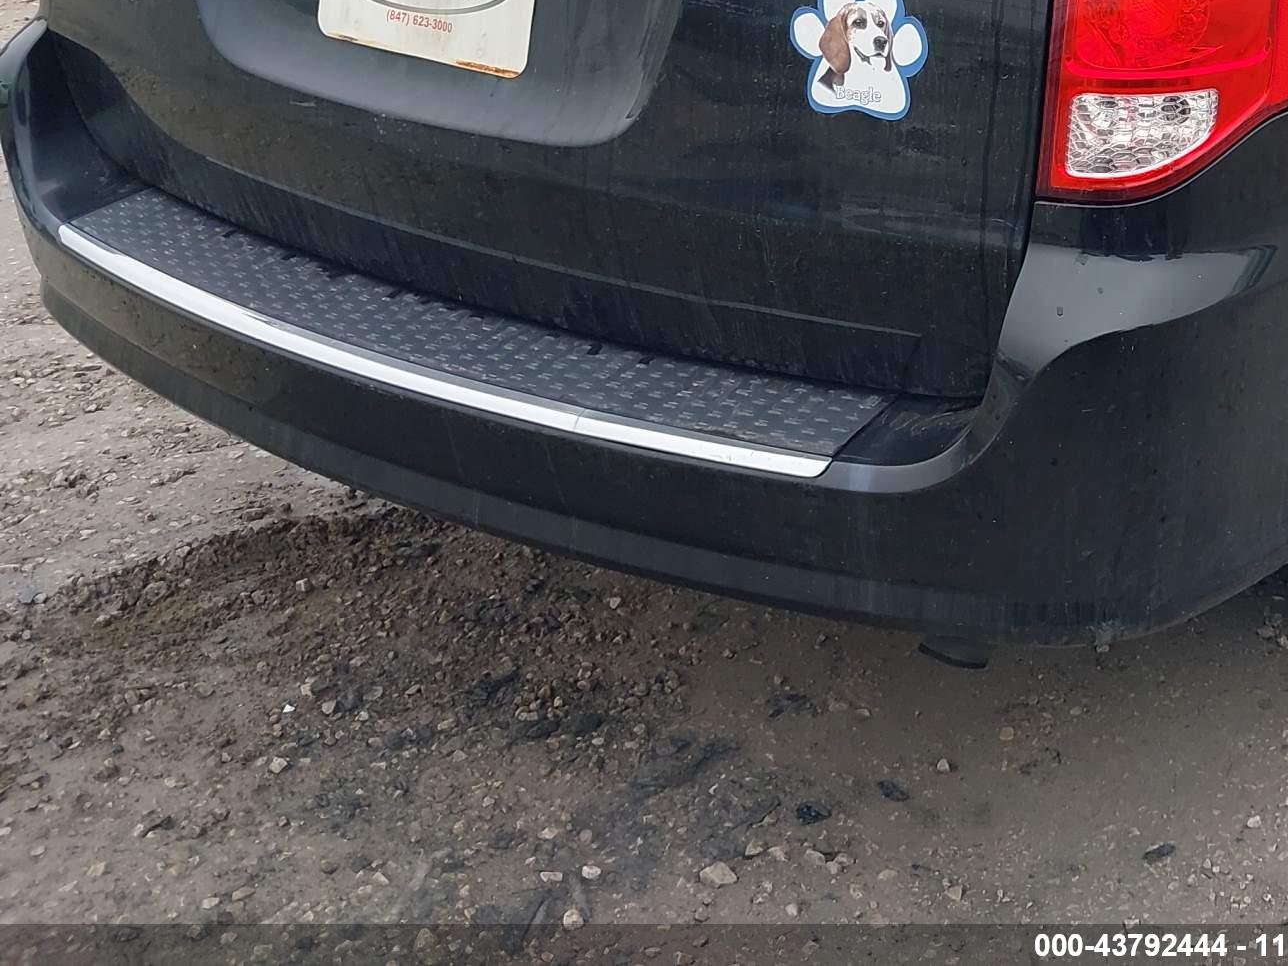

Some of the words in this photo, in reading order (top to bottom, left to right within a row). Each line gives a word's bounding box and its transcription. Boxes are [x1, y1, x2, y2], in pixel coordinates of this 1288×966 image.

[386, 9, 410, 26] (847)
[412, 14, 453, 33] 623-3000
[835, 86, 882, 105] Beagle
